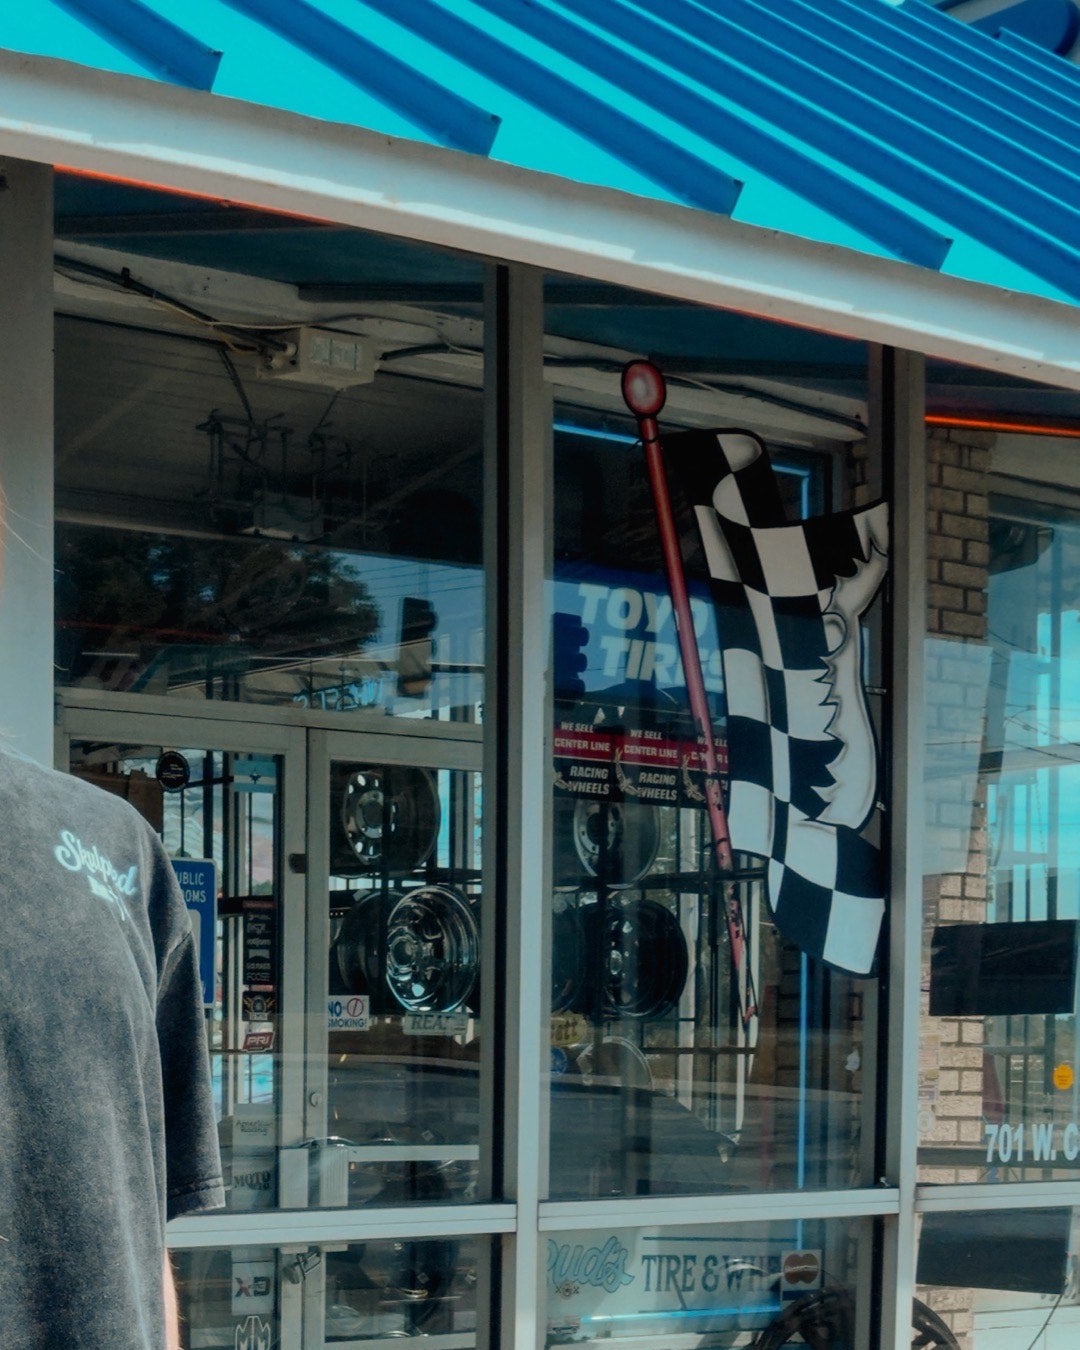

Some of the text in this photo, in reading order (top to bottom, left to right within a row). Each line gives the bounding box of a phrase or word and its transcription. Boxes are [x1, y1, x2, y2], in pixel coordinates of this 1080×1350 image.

[561, 722, 594, 733] WE SELL
[630, 730, 662, 740] WE SELL
[555, 738, 611, 752] CENTER LINE
[624, 745, 678, 759] CENTER LINE
[569, 766, 609, 780] RACING
[639, 772, 676, 785] RACING
[568, 781, 610, 795] WHEELS
[637, 787, 677, 801] WHEELS
[177, 871, 205, 885] UBLIC
[985, 1123, 1024, 1163] 701
[1032, 1123, 1056, 1162] W.
[641, 1254, 700, 1292] TIRE
[701, 1254, 721, 1292] &
[723, 1255, 782, 1292] WHE
